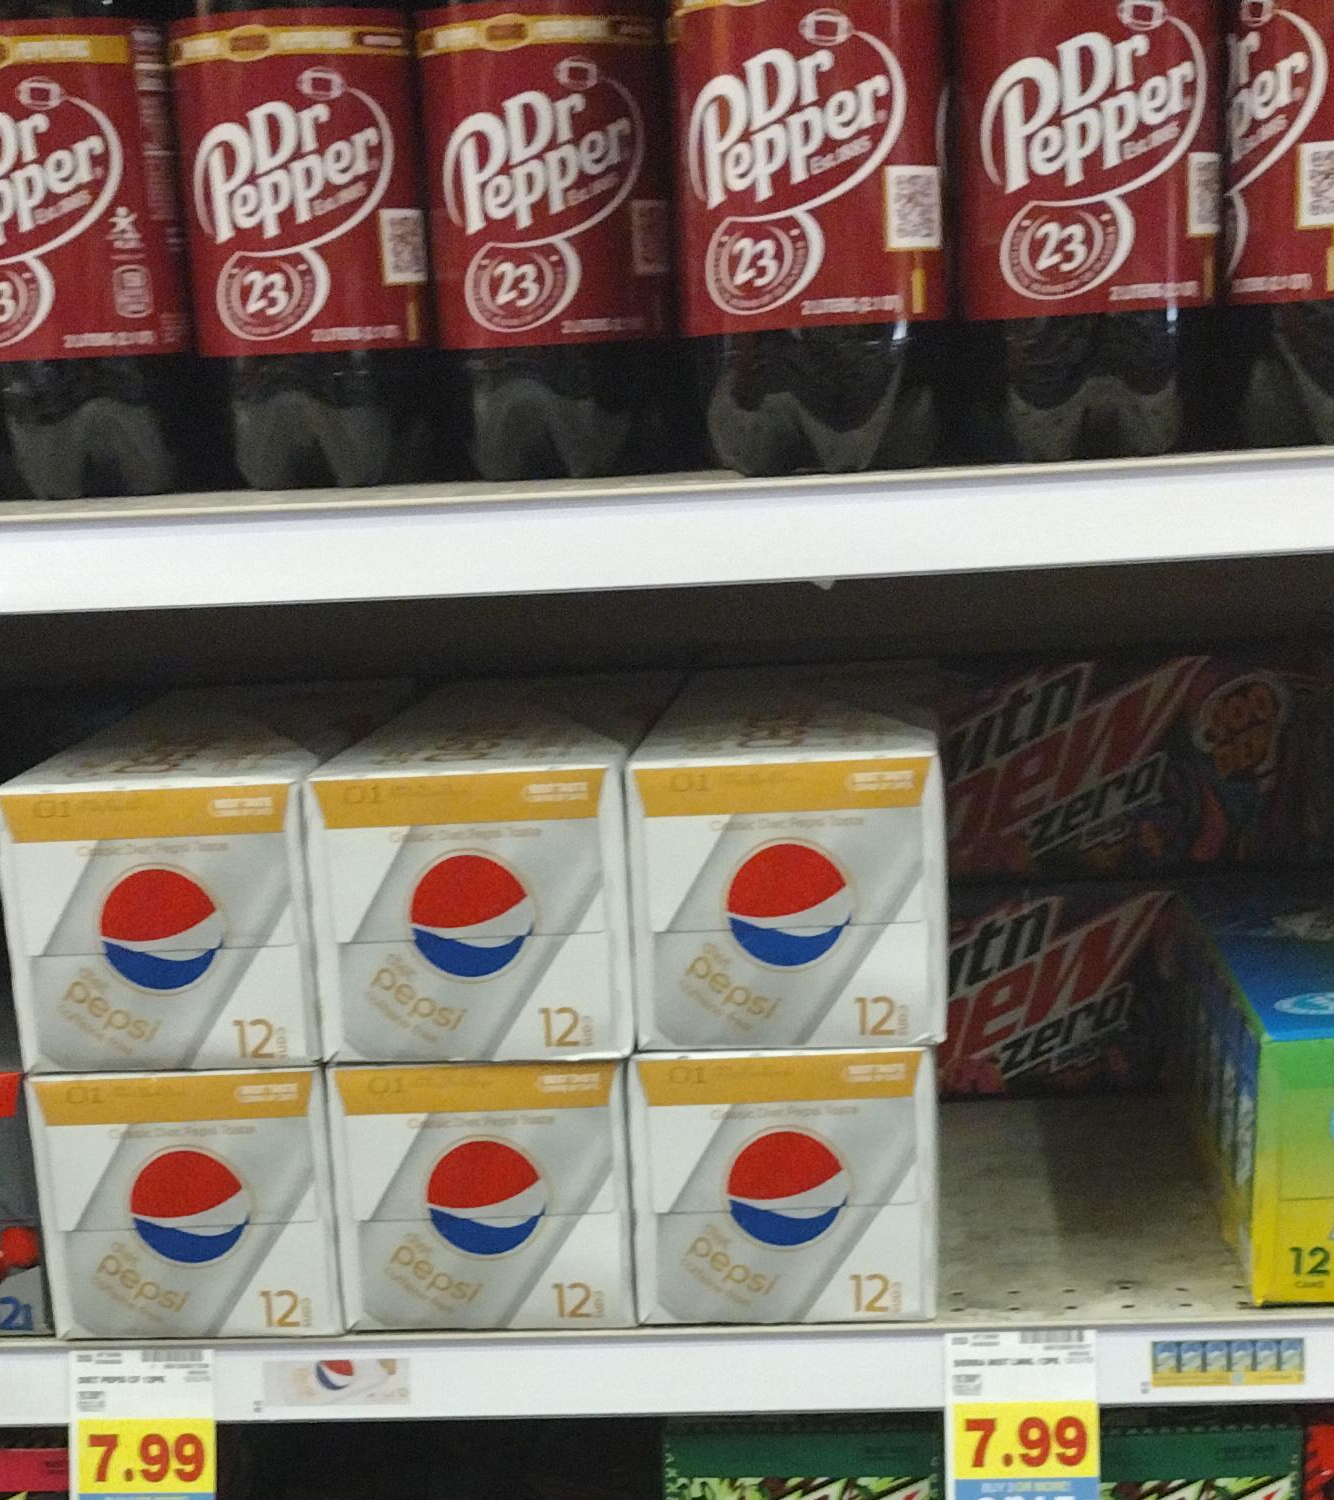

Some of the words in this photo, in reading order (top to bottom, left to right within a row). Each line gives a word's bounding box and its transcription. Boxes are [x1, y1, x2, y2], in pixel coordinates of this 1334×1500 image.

[745, 48, 835, 107] Dr
[1057, 32, 1149, 90] Dr
[689, 74, 889, 209] Pepper
[983, 57, 1192, 193] Pepper
[731, 238, 780, 285] 23
[1035, 225, 1087, 270] 23
[63, 981, 163, 1042] pepsi
[684, 952, 781, 1020] pepsi
[233, 1018, 275, 1059] 12
[540, 1008, 581, 1047] 12
[855, 996, 897, 1036] 12
[1290, 1246, 1330, 1276] 12
[88, 1433, 205, 1483] 7.99
[965, 1416, 1088, 1468] 7.99
